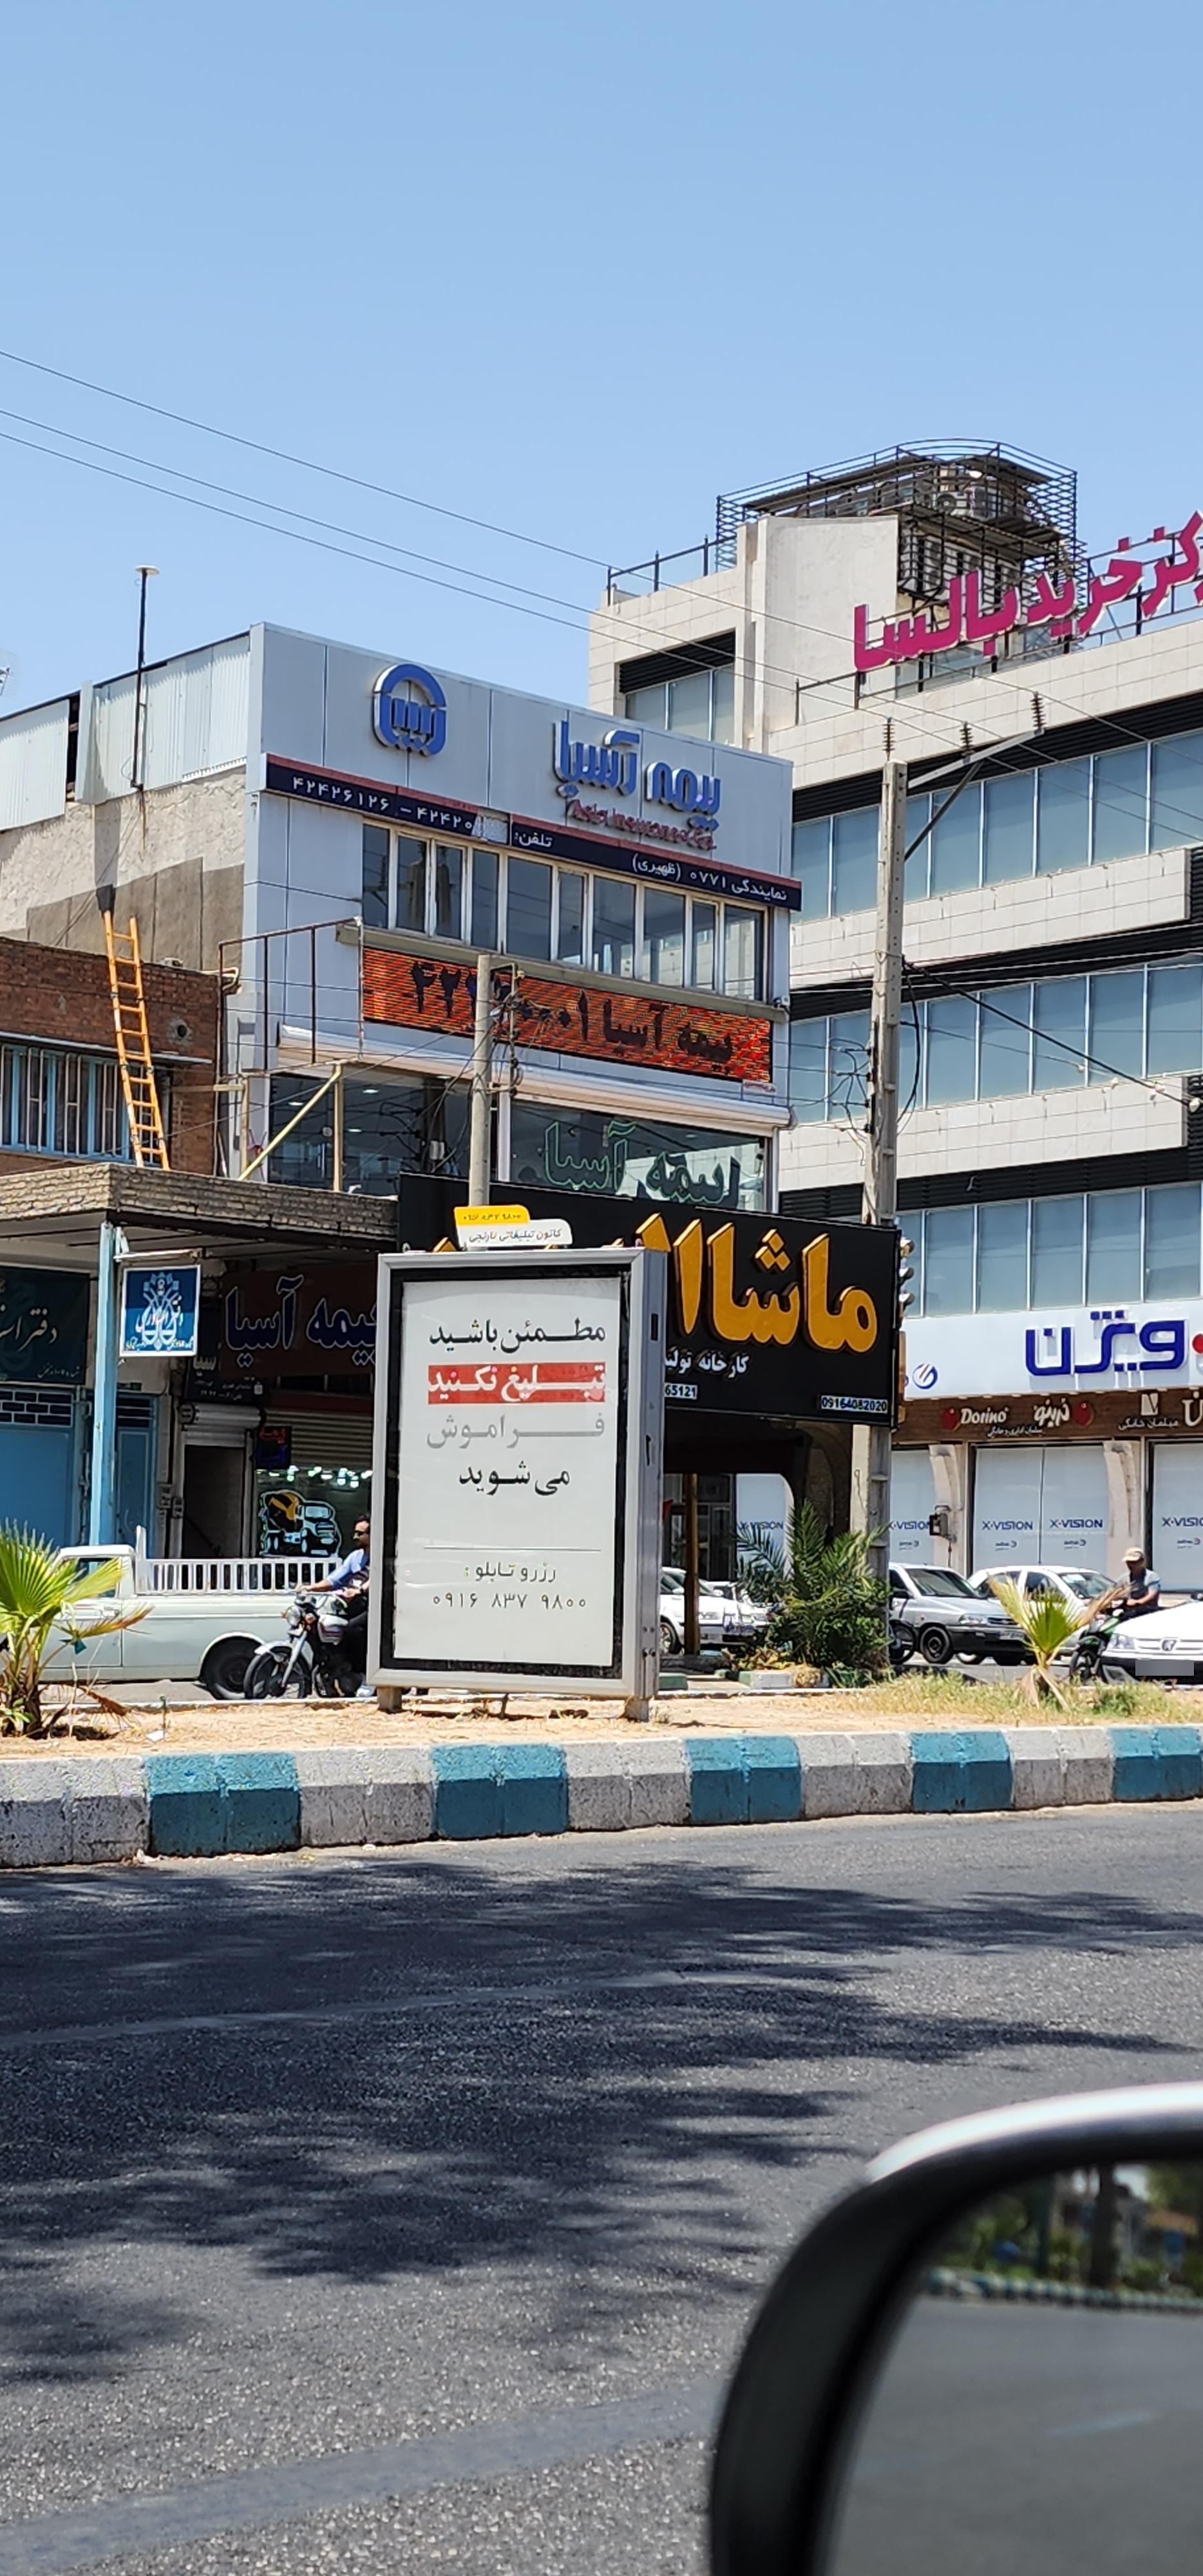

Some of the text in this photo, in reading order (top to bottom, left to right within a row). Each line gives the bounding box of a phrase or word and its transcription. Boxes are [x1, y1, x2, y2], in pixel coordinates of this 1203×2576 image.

[1141, 511, 1203, 616] کز
[1027, 536, 1144, 640] خرید
[292, 776, 390, 811] ۴۲۴۲۶۱۲۶
[554, 720, 721, 832] بیمه آسیا
[567, 799, 609, 826] Asia
[632, 853, 681, 882] (ظهیری)
[690, 871, 726, 888] ۰۷۷۱
[731, 882, 788, 901] نمایندگی
[536, 1227, 563, 1240] کانون
[636, 1212, 878, 1353] ماشاا
[18, 1307, 58, 1352] دفتر
[225, 1274, 304, 1368] آسیا
[429, 1317, 606, 1354] مطمئن باشید
[1025, 1310, 1186, 1376] ویژن
[665, 1349, 692, 1374] تولی
[428, 1365, 606, 1403] تبلیغ نکنید
[426, 1412, 605, 1449] فراموش
[961, 1408, 1007, 1424] Dorino
[459, 1460, 571, 1496] می شوید
[475, 1561, 515, 1584] تابلو
[520, 1562, 556, 1582] رزرو
[433, 1592, 586, 1610] ۰۹۱۶ ۸۳۷ ۹۸۰۰
